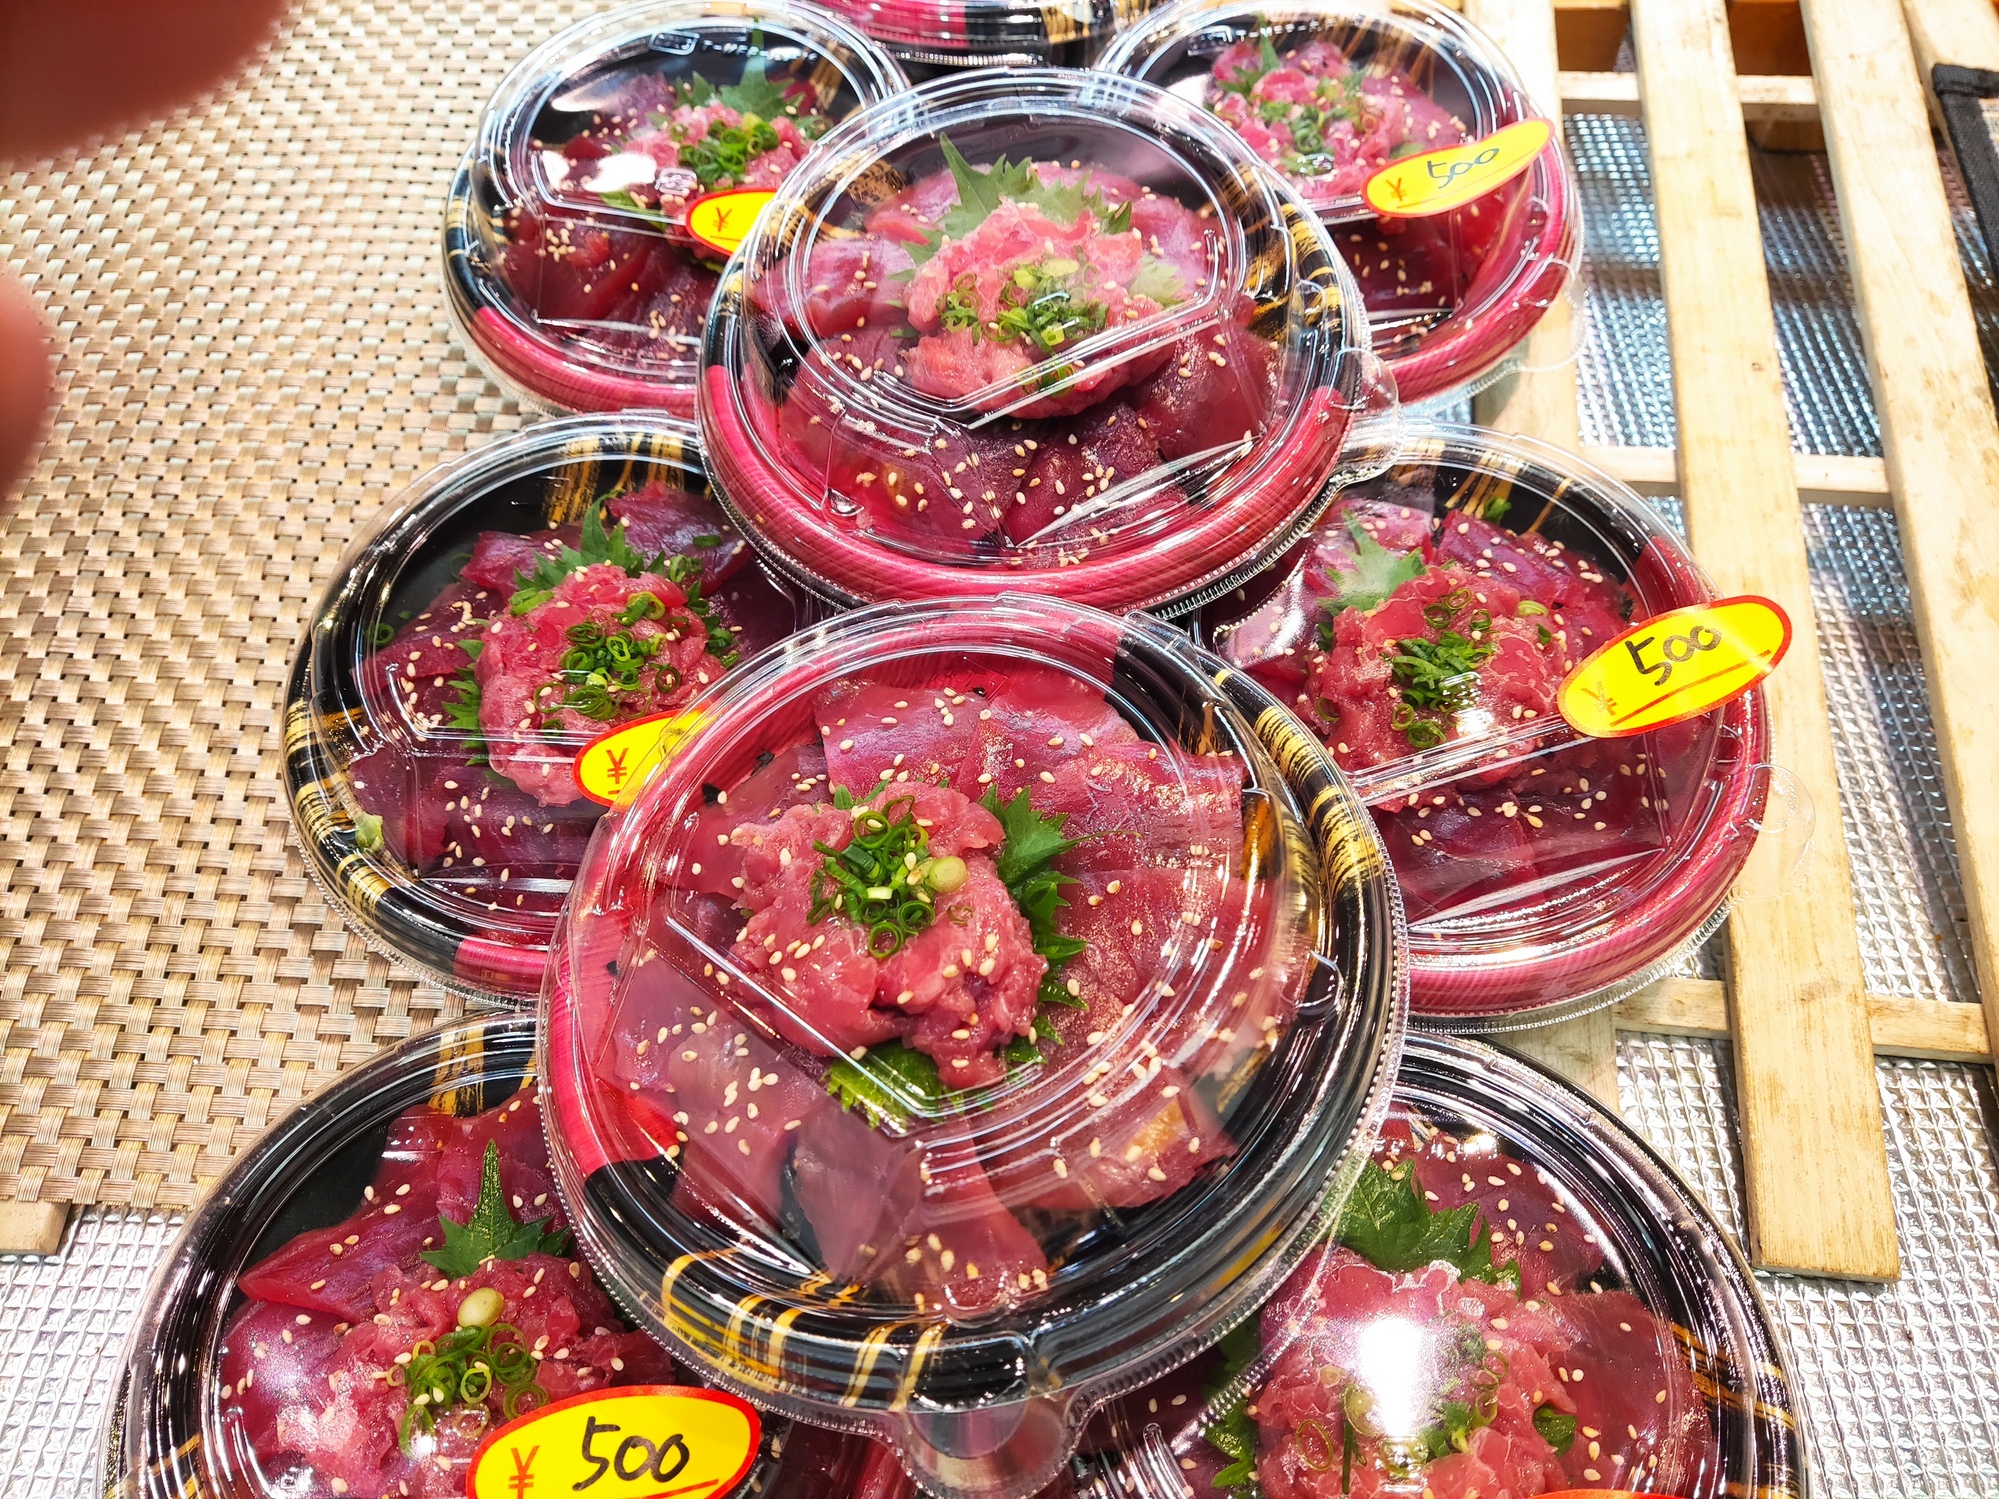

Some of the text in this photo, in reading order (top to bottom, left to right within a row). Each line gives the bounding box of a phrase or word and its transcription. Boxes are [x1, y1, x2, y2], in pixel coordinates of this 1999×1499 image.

[1385, 148, 1500, 201] ¥ 500
[712, 206, 733, 232] ¥
[1580, 625, 1723, 716] ¥ 500
[606, 747, 629, 784] ¥
[508, 1415, 690, 1499] ¥ 500
